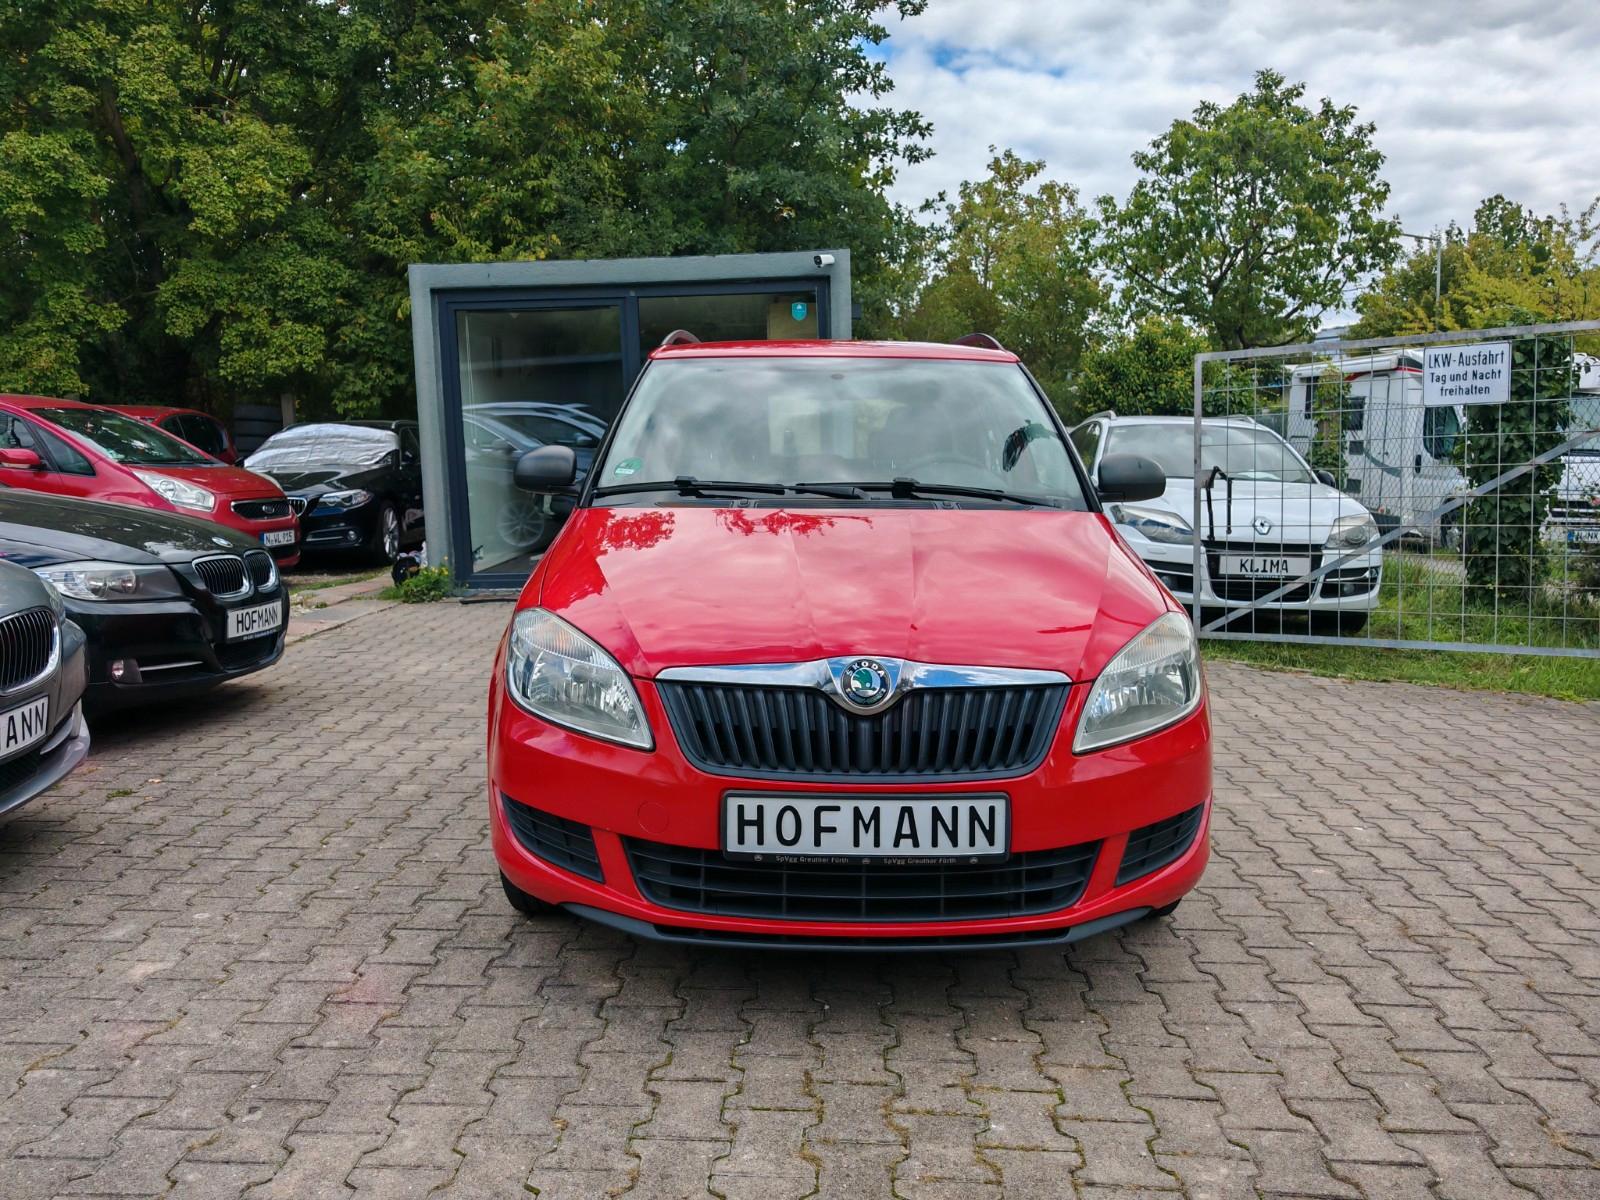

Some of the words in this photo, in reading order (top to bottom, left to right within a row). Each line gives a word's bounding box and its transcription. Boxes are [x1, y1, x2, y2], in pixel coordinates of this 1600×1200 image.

[1428, 350, 1504, 369] LKW-Ausfahrt
[1430, 372, 1447, 385] Tag
[1450, 370, 1468, 382] und
[1472, 368, 1501, 381] Nacht
[1440, 384, 1490, 397] freihalten
[1239, 558, 1288, 574] KLIMA
[236, 604, 278, 634] HOFMANN
[6, 702, 45, 749] ANN
[737, 804, 996, 848] HOFMANN
